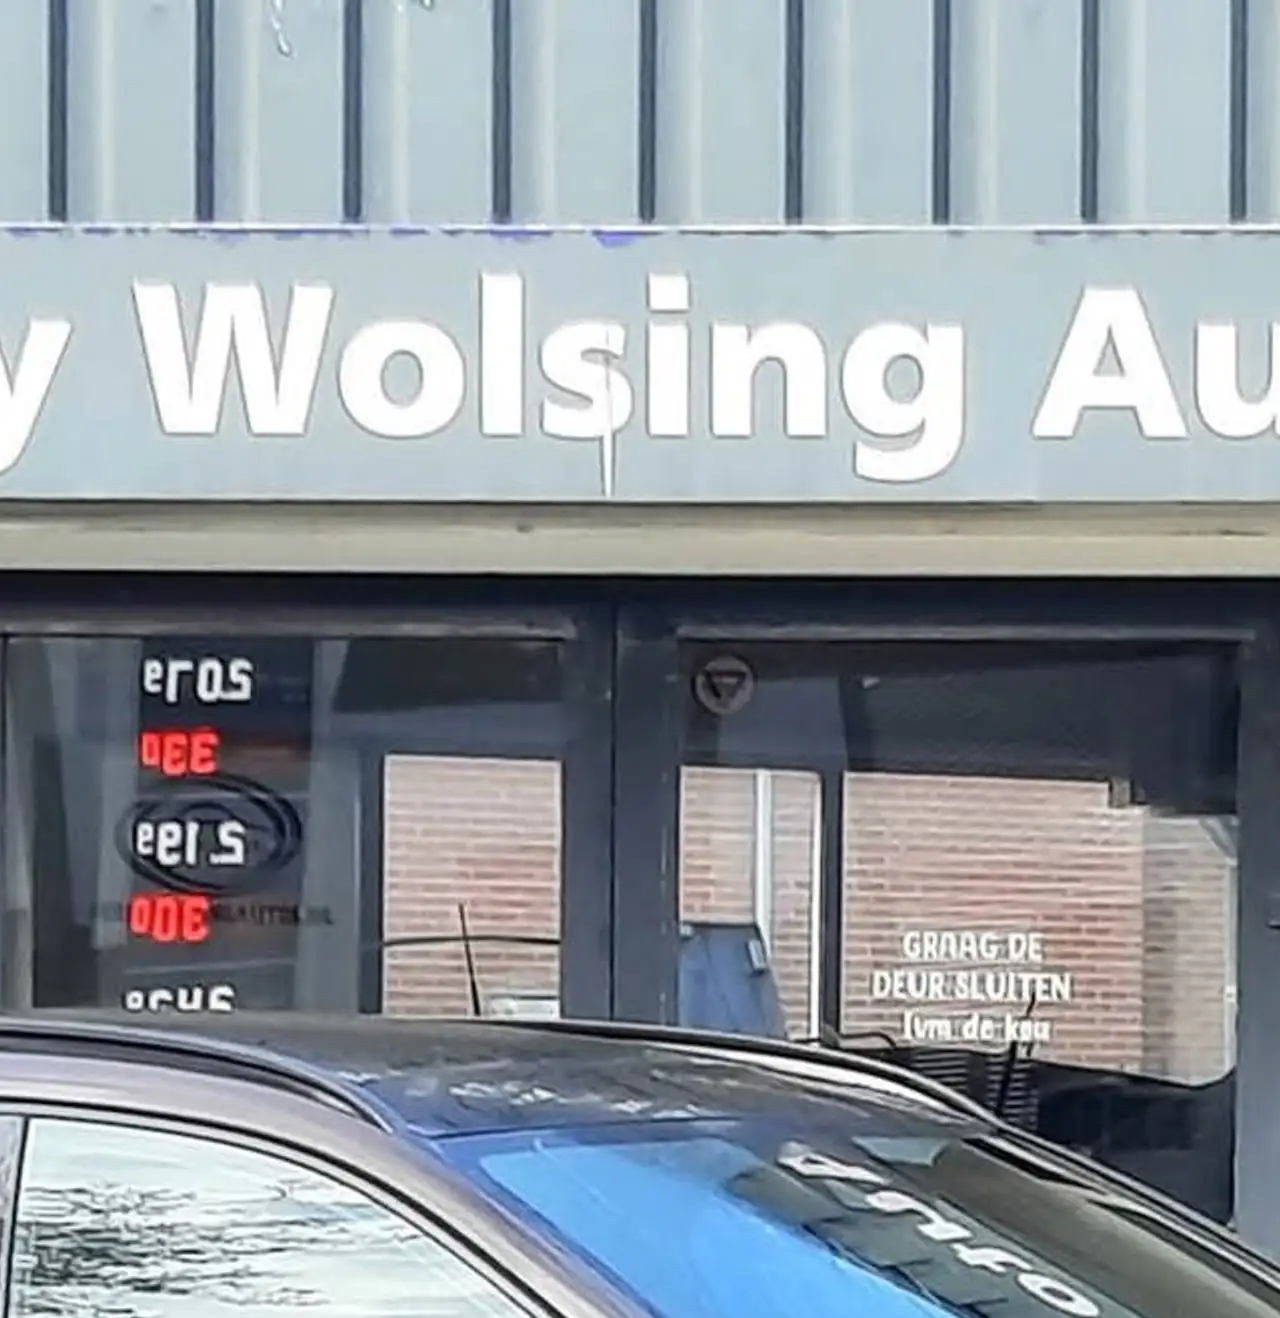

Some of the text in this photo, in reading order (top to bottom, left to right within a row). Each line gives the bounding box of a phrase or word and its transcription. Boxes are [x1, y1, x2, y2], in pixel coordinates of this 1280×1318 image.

[130, 271, 966, 483] Wolsing
[902, 930, 1045, 962] GRAAG DE
[873, 971, 1071, 1002] DEUR SLUITEN
